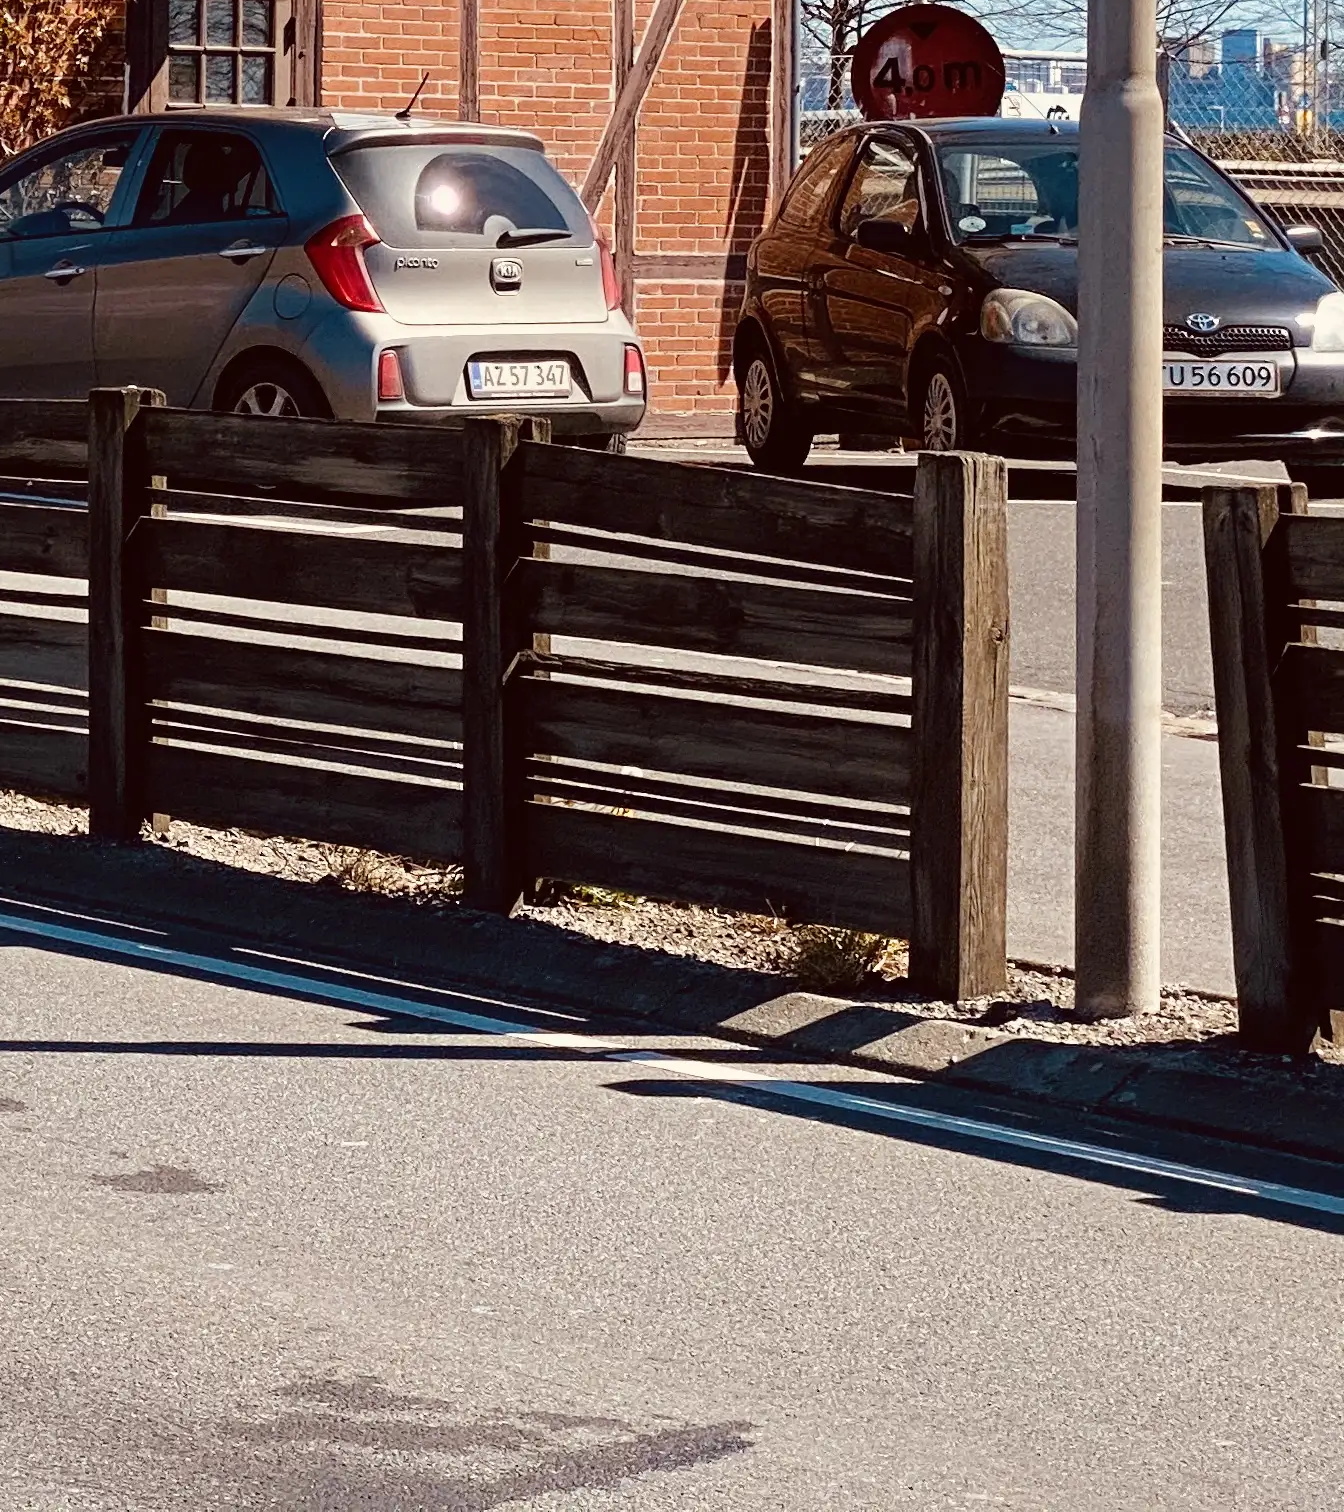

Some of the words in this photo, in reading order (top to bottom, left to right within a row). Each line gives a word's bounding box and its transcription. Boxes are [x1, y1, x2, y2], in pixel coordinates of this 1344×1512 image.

[394, 256, 440, 272] picanto
[499, 264, 520, 279] KIA
[484, 366, 506, 387] AZ
[509, 365, 529, 386] 57
[534, 364, 565, 386] 347
[1192, 366, 1221, 387] 56
[1227, 366, 1271, 387] 609
